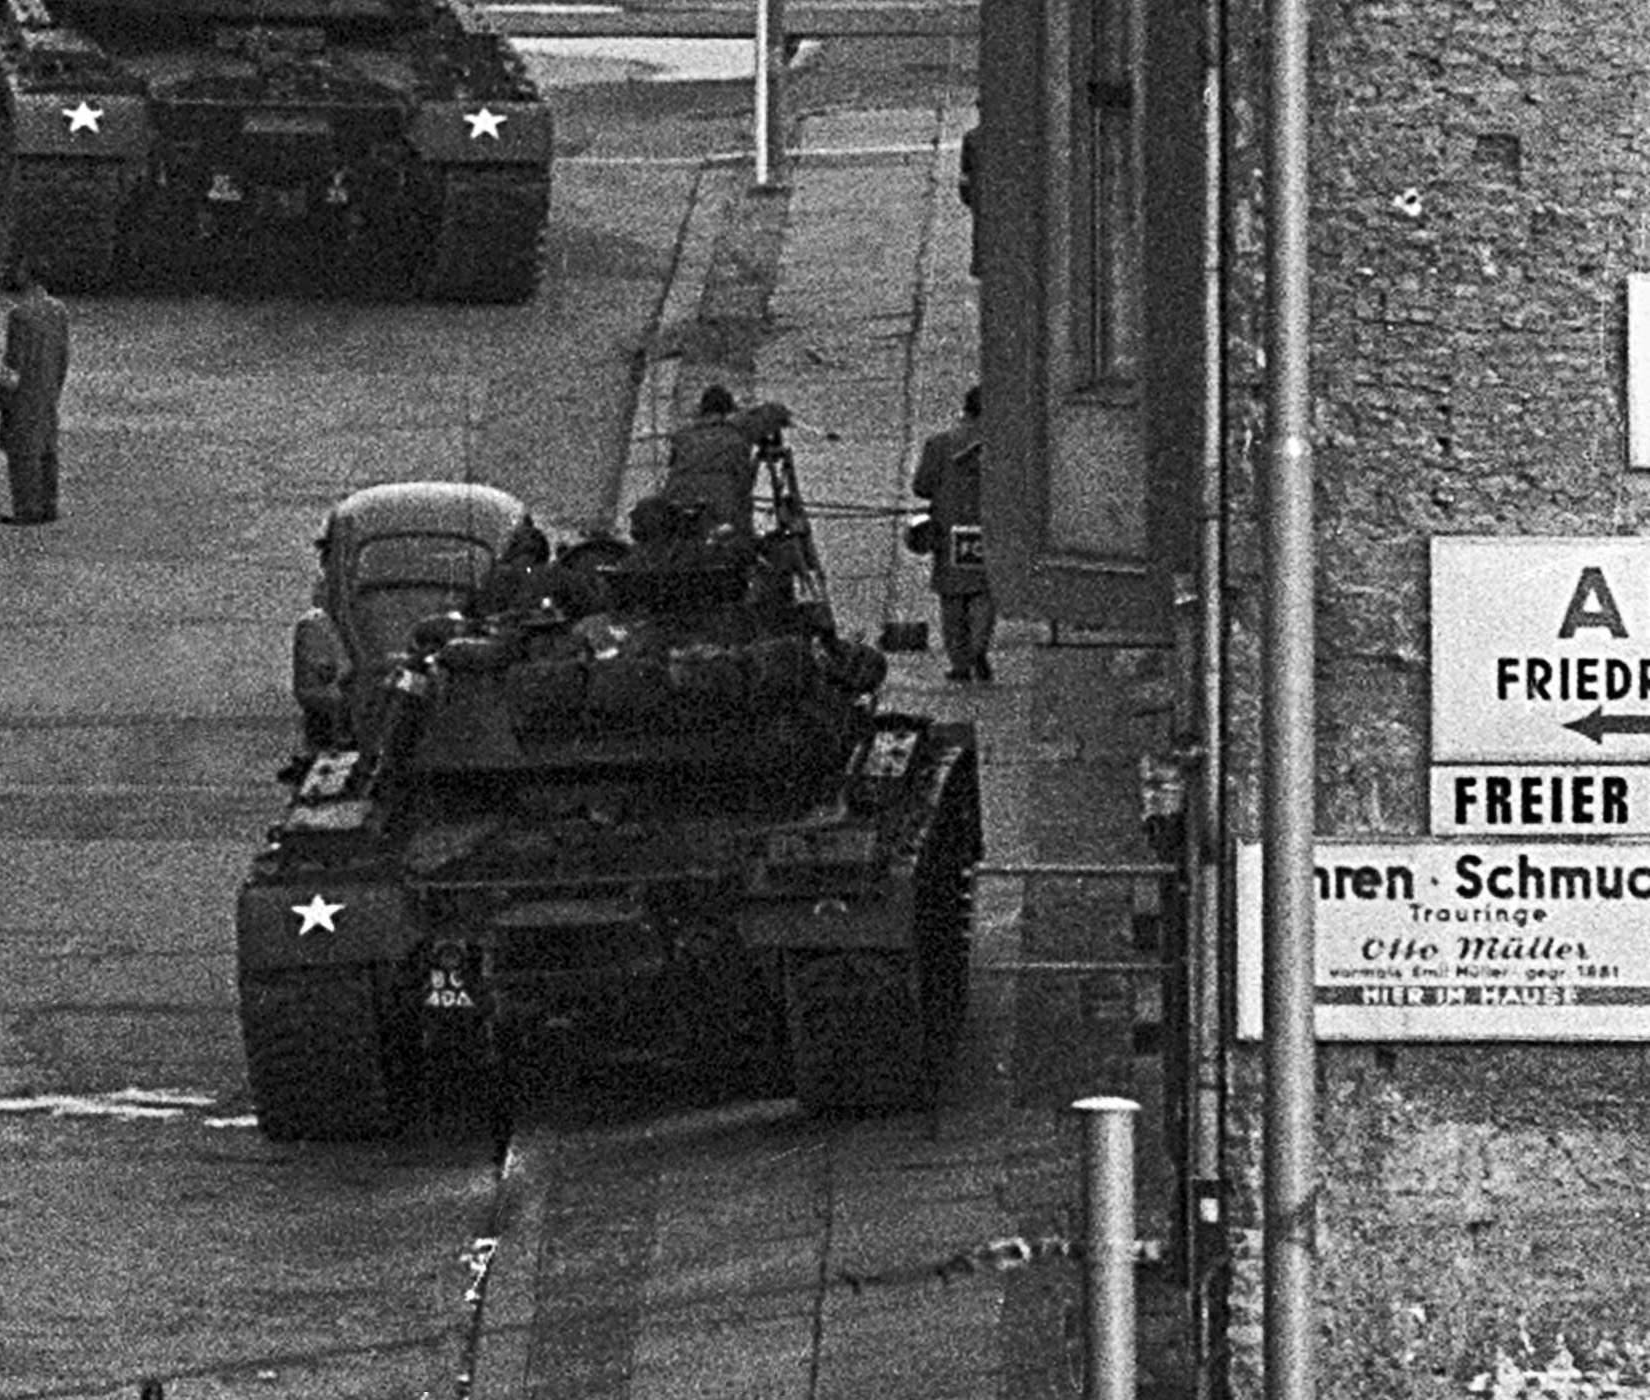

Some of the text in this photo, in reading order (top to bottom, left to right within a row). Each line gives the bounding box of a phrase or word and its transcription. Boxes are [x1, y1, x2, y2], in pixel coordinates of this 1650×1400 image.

[1557, 566, 1630, 639] A
[1454, 775, 1629, 825] FREIER
[1455, 854, 1650, 900] Schmuc
[1408, 903, 1548, 927] Trauringe
[1361, 936, 1590, 961] Otto Müller
[1363, 987, 1425, 1005] HIER
[1481, 987, 1578, 1005] HAUSE
